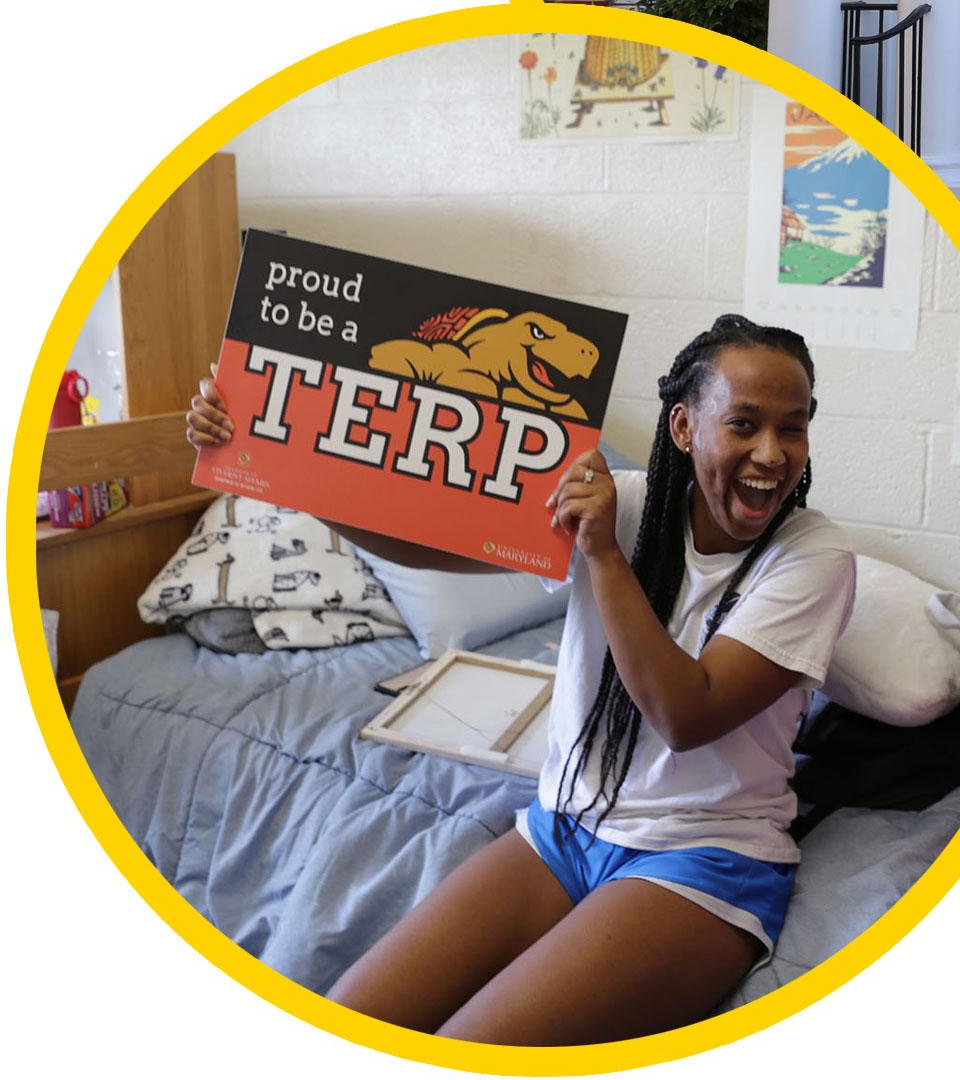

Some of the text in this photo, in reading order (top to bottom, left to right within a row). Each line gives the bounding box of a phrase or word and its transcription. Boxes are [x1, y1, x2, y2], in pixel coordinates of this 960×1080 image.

[264, 261, 363, 303] proud
[260, 295, 358, 343] to be a
[247, 343, 569, 504] TERP
[495, 549, 552, 570] MARYLAND
